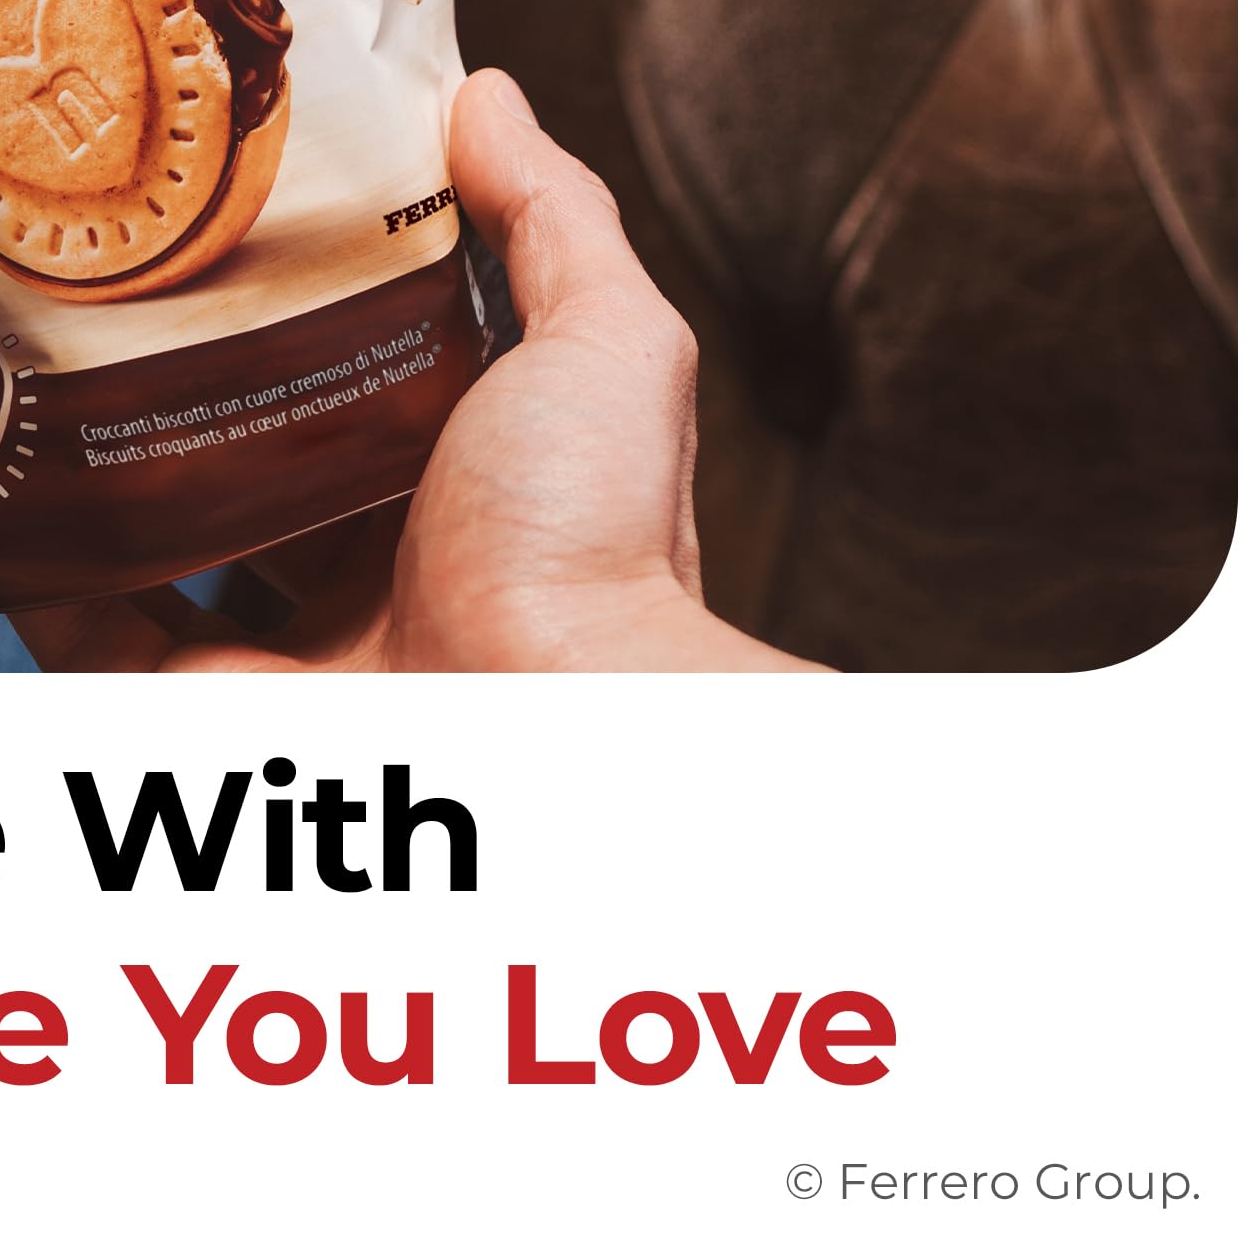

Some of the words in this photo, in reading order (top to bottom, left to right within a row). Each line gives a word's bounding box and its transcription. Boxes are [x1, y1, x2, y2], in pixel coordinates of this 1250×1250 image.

[81, 415, 152, 442] Croccanti
[153, 403, 212, 431] biscotti
[215, 398, 243, 417] con
[246, 384, 288, 409] cuore
[290, 361, 352, 394] cremoso
[355, 349, 371, 371] di
[85, 444, 147, 468] Biscuits
[149, 430, 225, 456] croquants
[228, 423, 247, 440] au
[250, 411, 288, 434] cœur
[291, 387, 361, 422] onctueux
[363, 376, 382, 395] de
